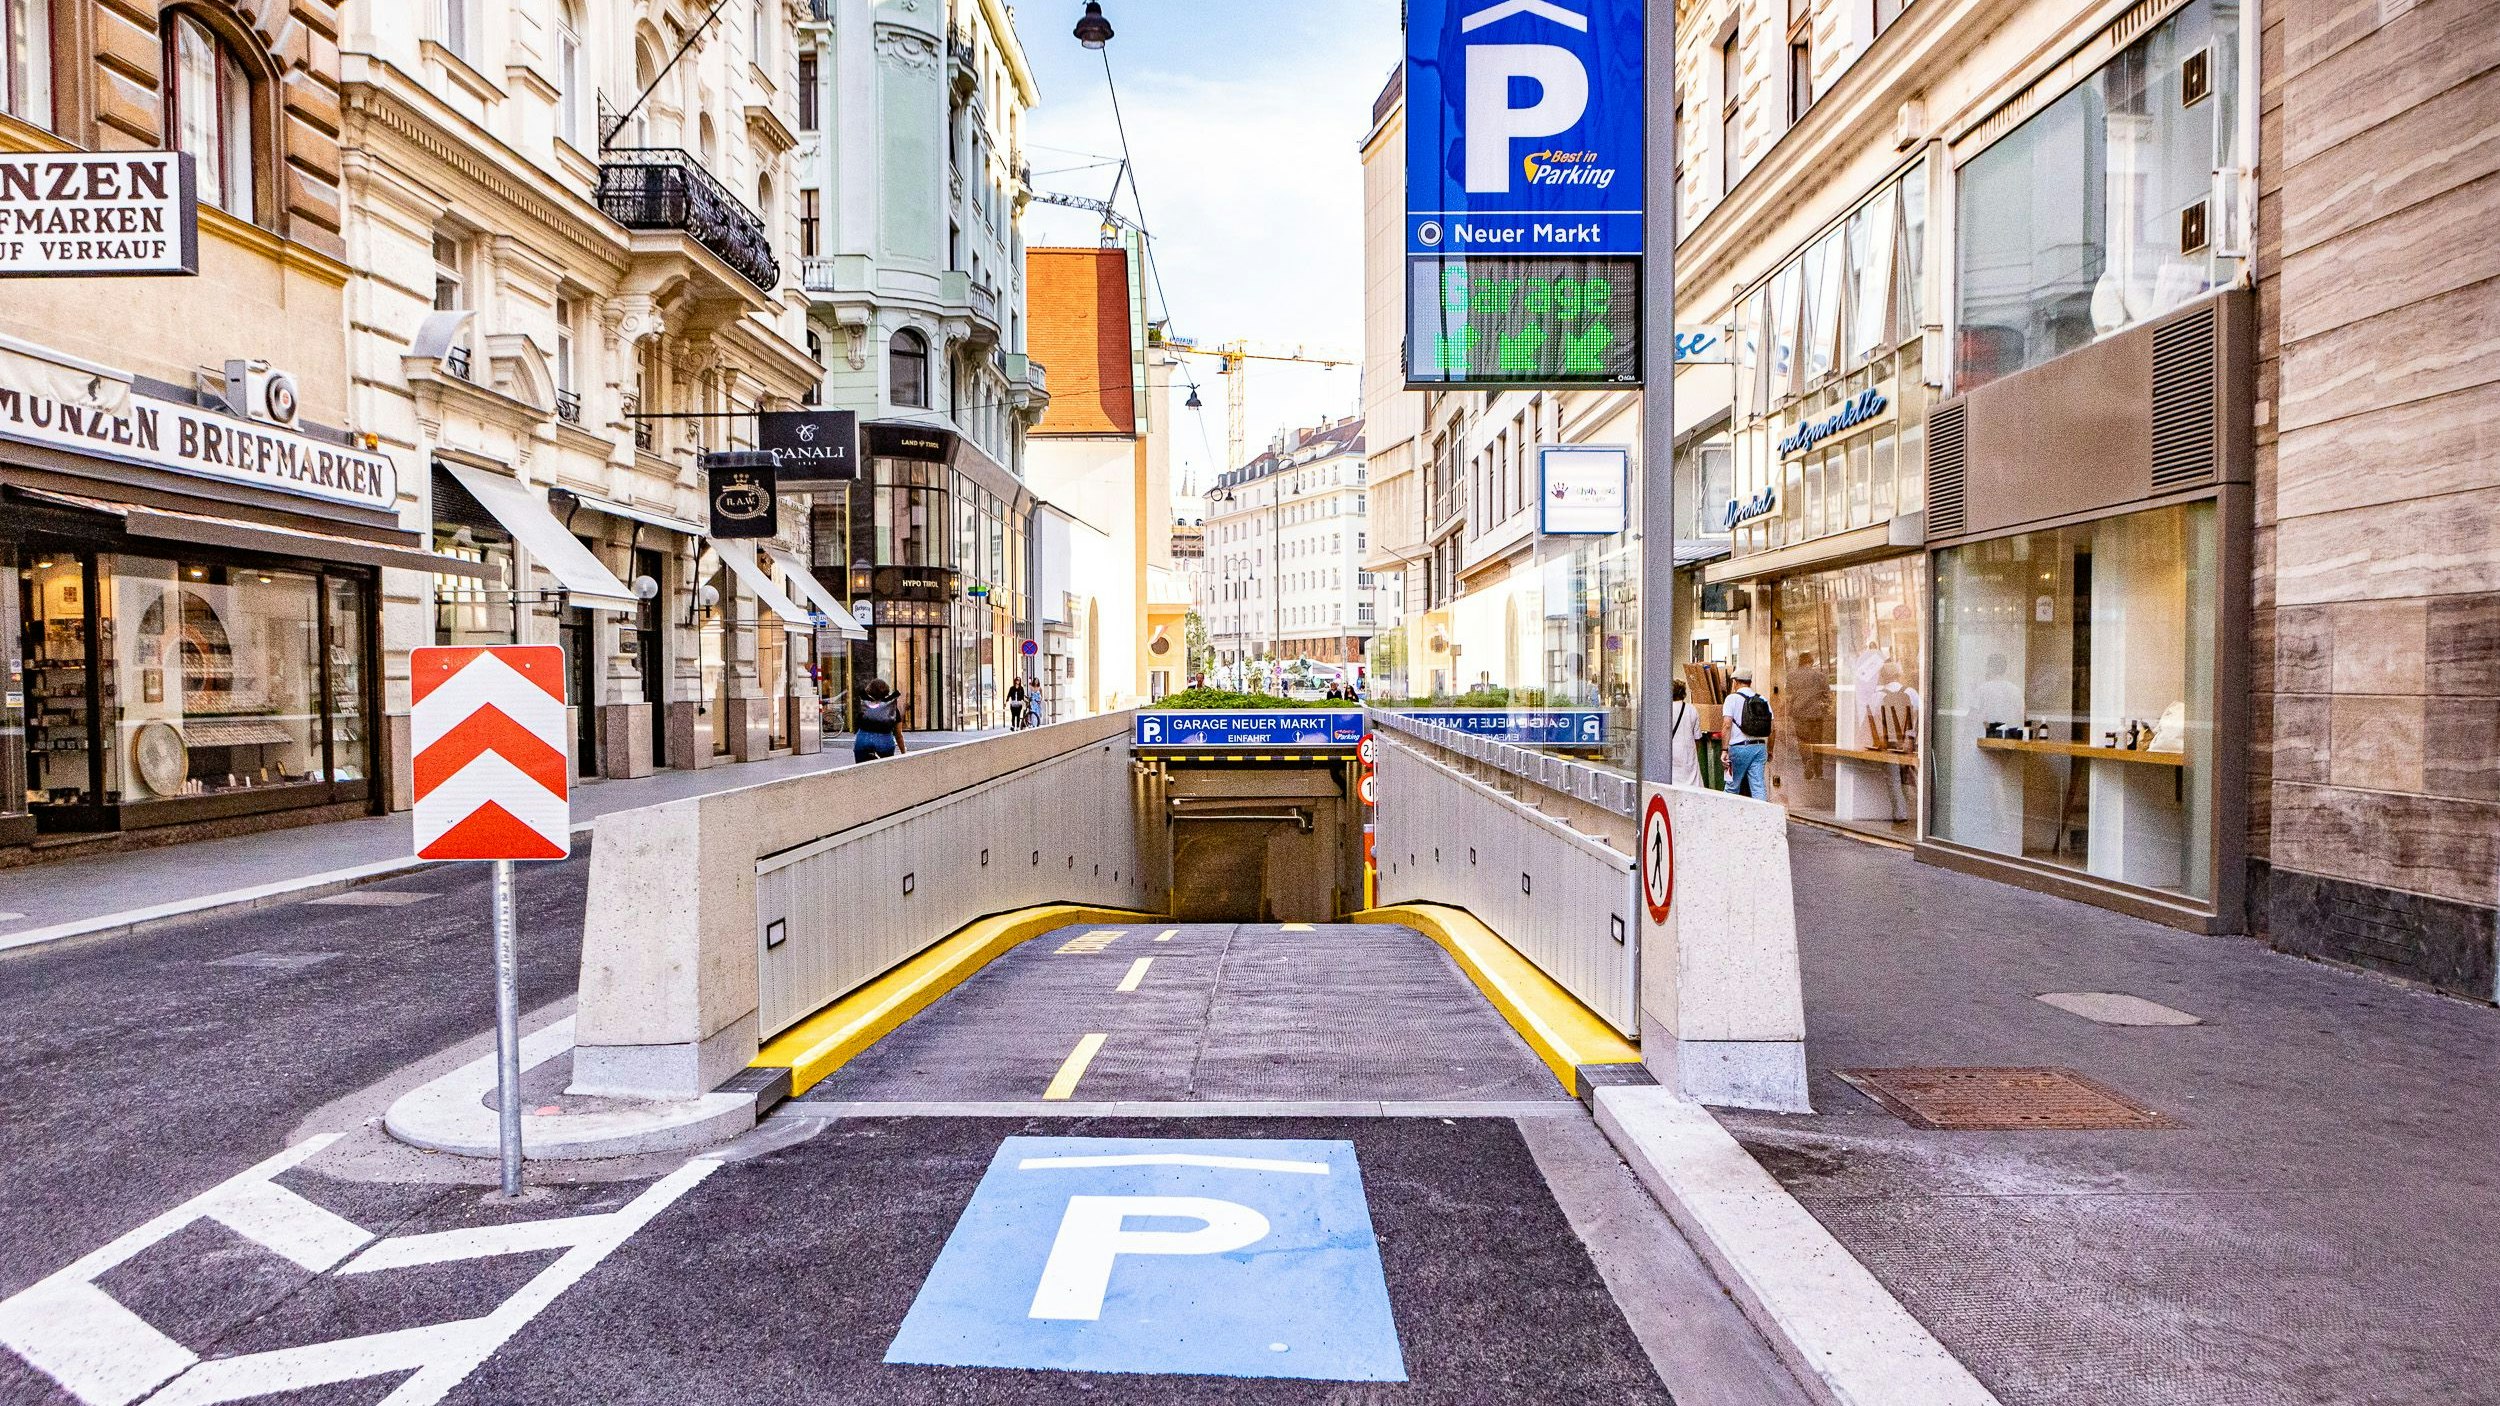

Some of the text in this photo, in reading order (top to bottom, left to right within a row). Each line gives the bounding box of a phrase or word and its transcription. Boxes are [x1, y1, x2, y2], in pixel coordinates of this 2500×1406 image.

[1466, 44, 1588, 193] P
[1550, 149, 1598, 163] Best in
[0, 162, 169, 200] NZEN
[1532, 164, 1616, 189] Parking
[1454, 223, 1601, 243] Neuer Markt
[40, 240, 166, 260] VERKAUF
[1440, 265, 1612, 320] Garage
[178, 416, 383, 498] BRIEFMARKEN
[1173, 718, 1326, 730] GARAGE NEUER MARKT
[1227, 734, 1272, 743] EINFAHRT
[1028, 1195, 1270, 1321] P
